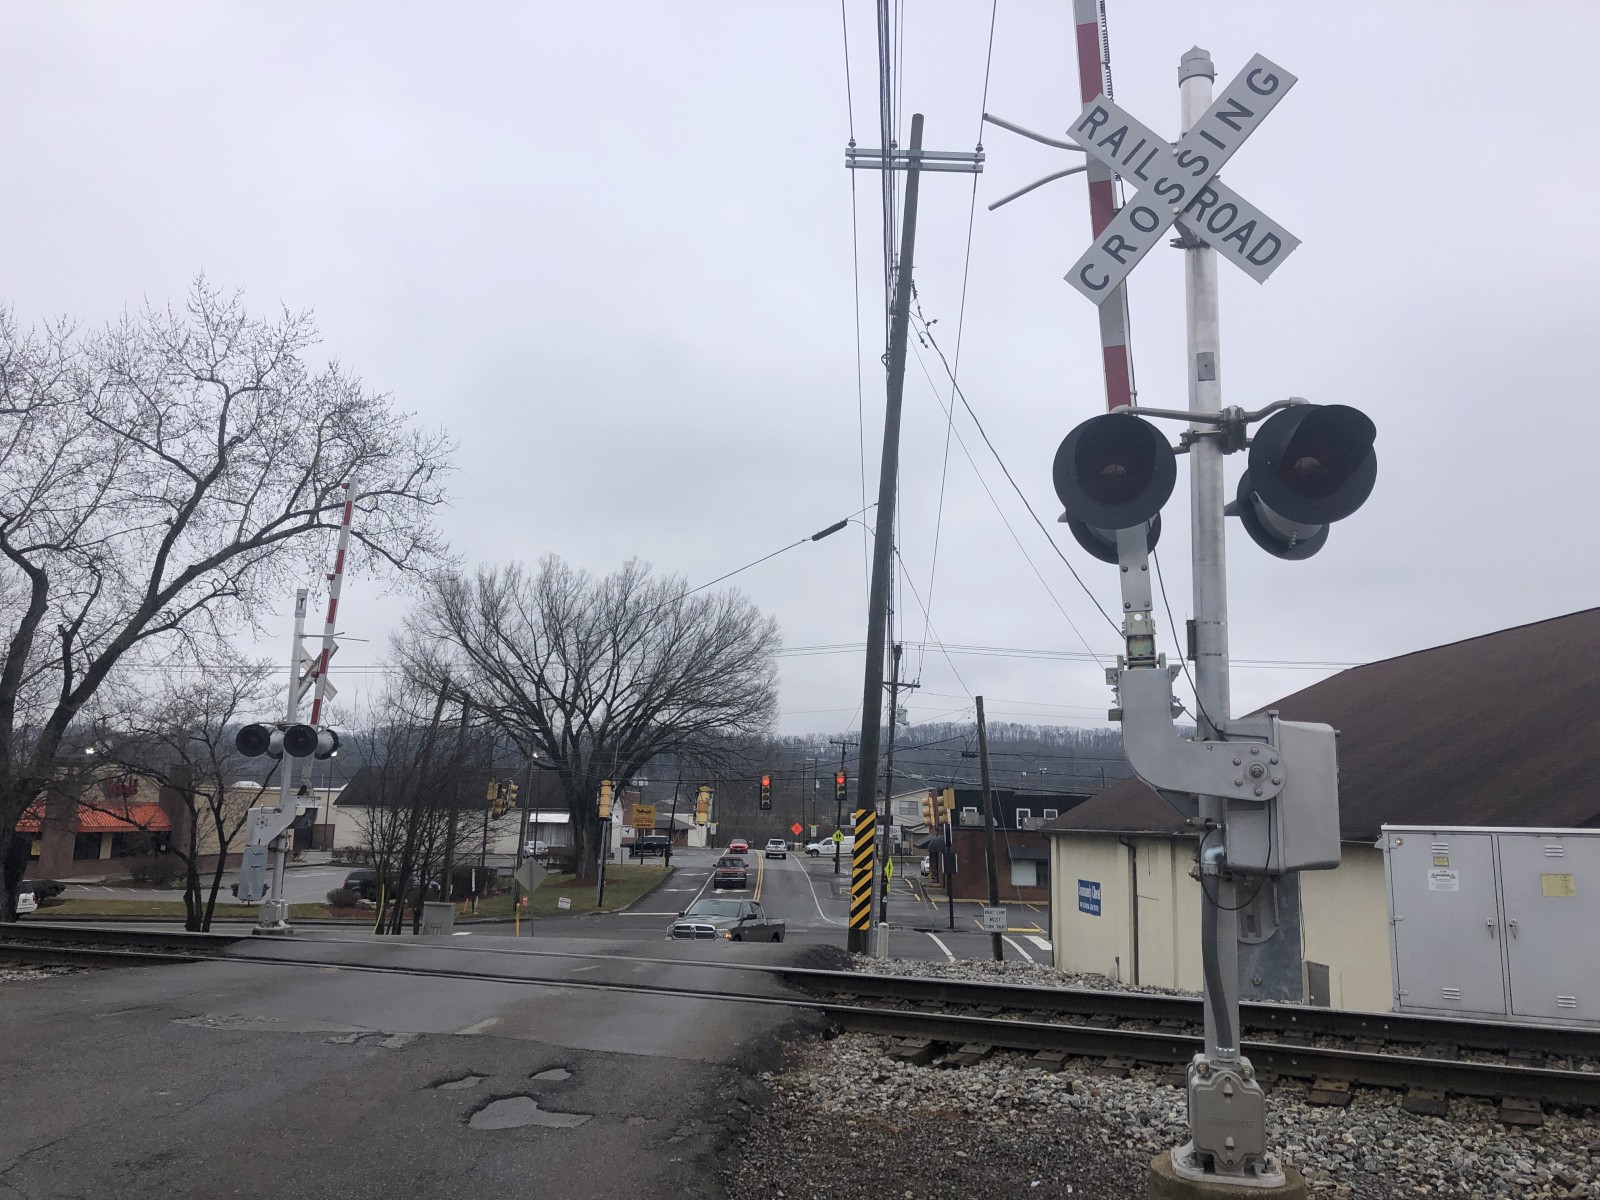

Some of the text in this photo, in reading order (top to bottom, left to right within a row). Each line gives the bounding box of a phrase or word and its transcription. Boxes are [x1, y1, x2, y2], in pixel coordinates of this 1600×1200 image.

[1077, 104, 1282, 266] RAIL ROAD
[1079, 67, 1280, 291] CROSSING
